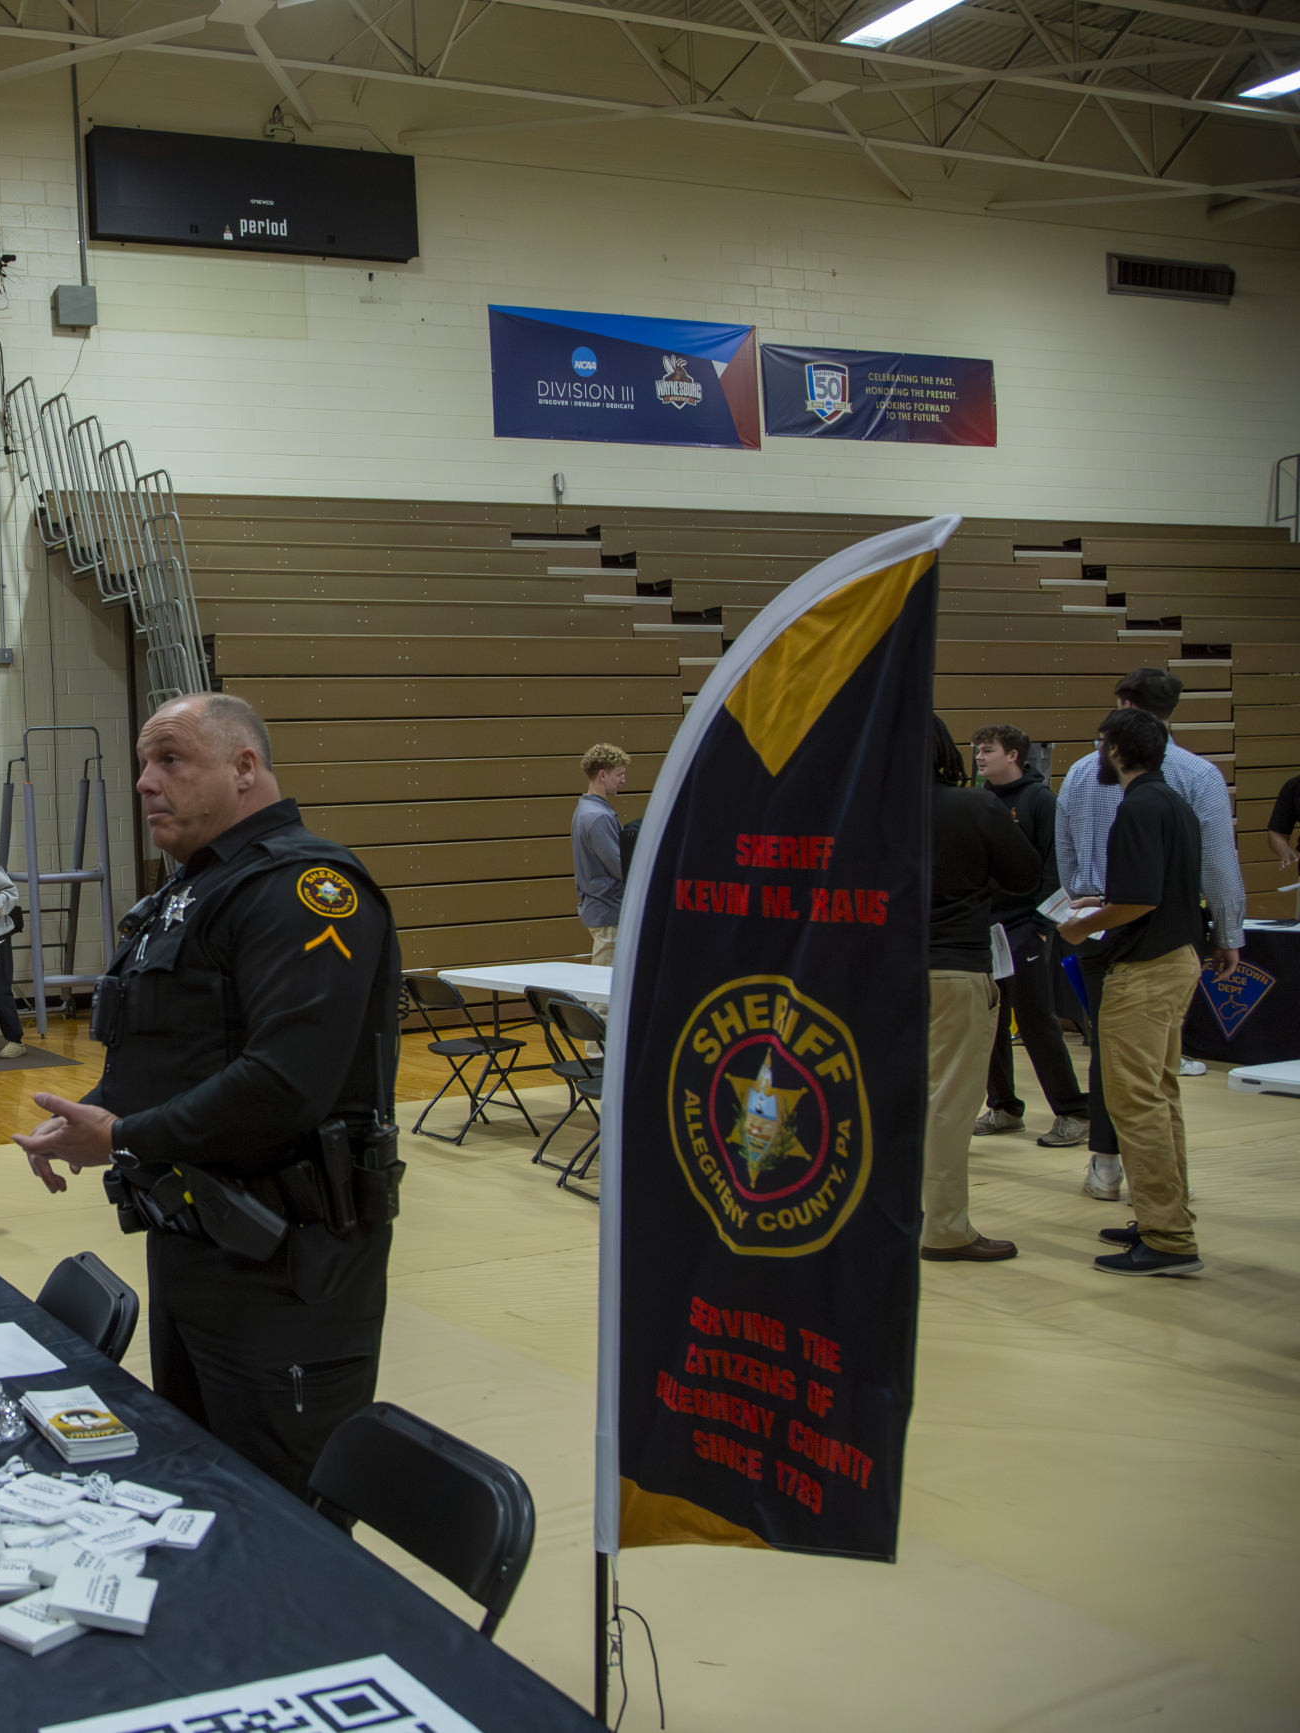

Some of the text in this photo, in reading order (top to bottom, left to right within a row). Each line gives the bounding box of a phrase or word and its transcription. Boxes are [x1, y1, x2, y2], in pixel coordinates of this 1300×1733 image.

[239, 218, 288, 237] period
[574, 360, 597, 370] NCAA
[656, 380, 702, 399] WAYNESBURG
[815, 376, 841, 400] 50
[868, 372, 955, 387] CELEBRATING THE PAST.
[537, 380, 634, 402] DIVISION III
[865, 386, 959, 400] HONORING THE PRESENT.
[606, 402, 635, 410] DEDICATE
[875, 401, 951, 413] LOOKING FORWARD
[886, 411, 942, 423] TO THE FUTURE.
[736, 834, 835, 870] SHERIFF
[305, 870, 351, 889] SHERIFF
[676, 878, 750, 916] KEVIN
[761, 885, 799, 920] M.
[1217, 982, 1244, 995] DEPT
[692, 993, 853, 1083] SHERIFF
[684, 1088, 749, 1229] ALLEGHENY
[835, 1118, 852, 1158] PA
[690, 1296, 842, 1374] SERVING THE
[684, 1343, 834, 1419] CITIZENS OF
[656, 1370, 874, 1491] ALLEGHENY COUNTY
[693, 1429, 764, 1481] SINCE
